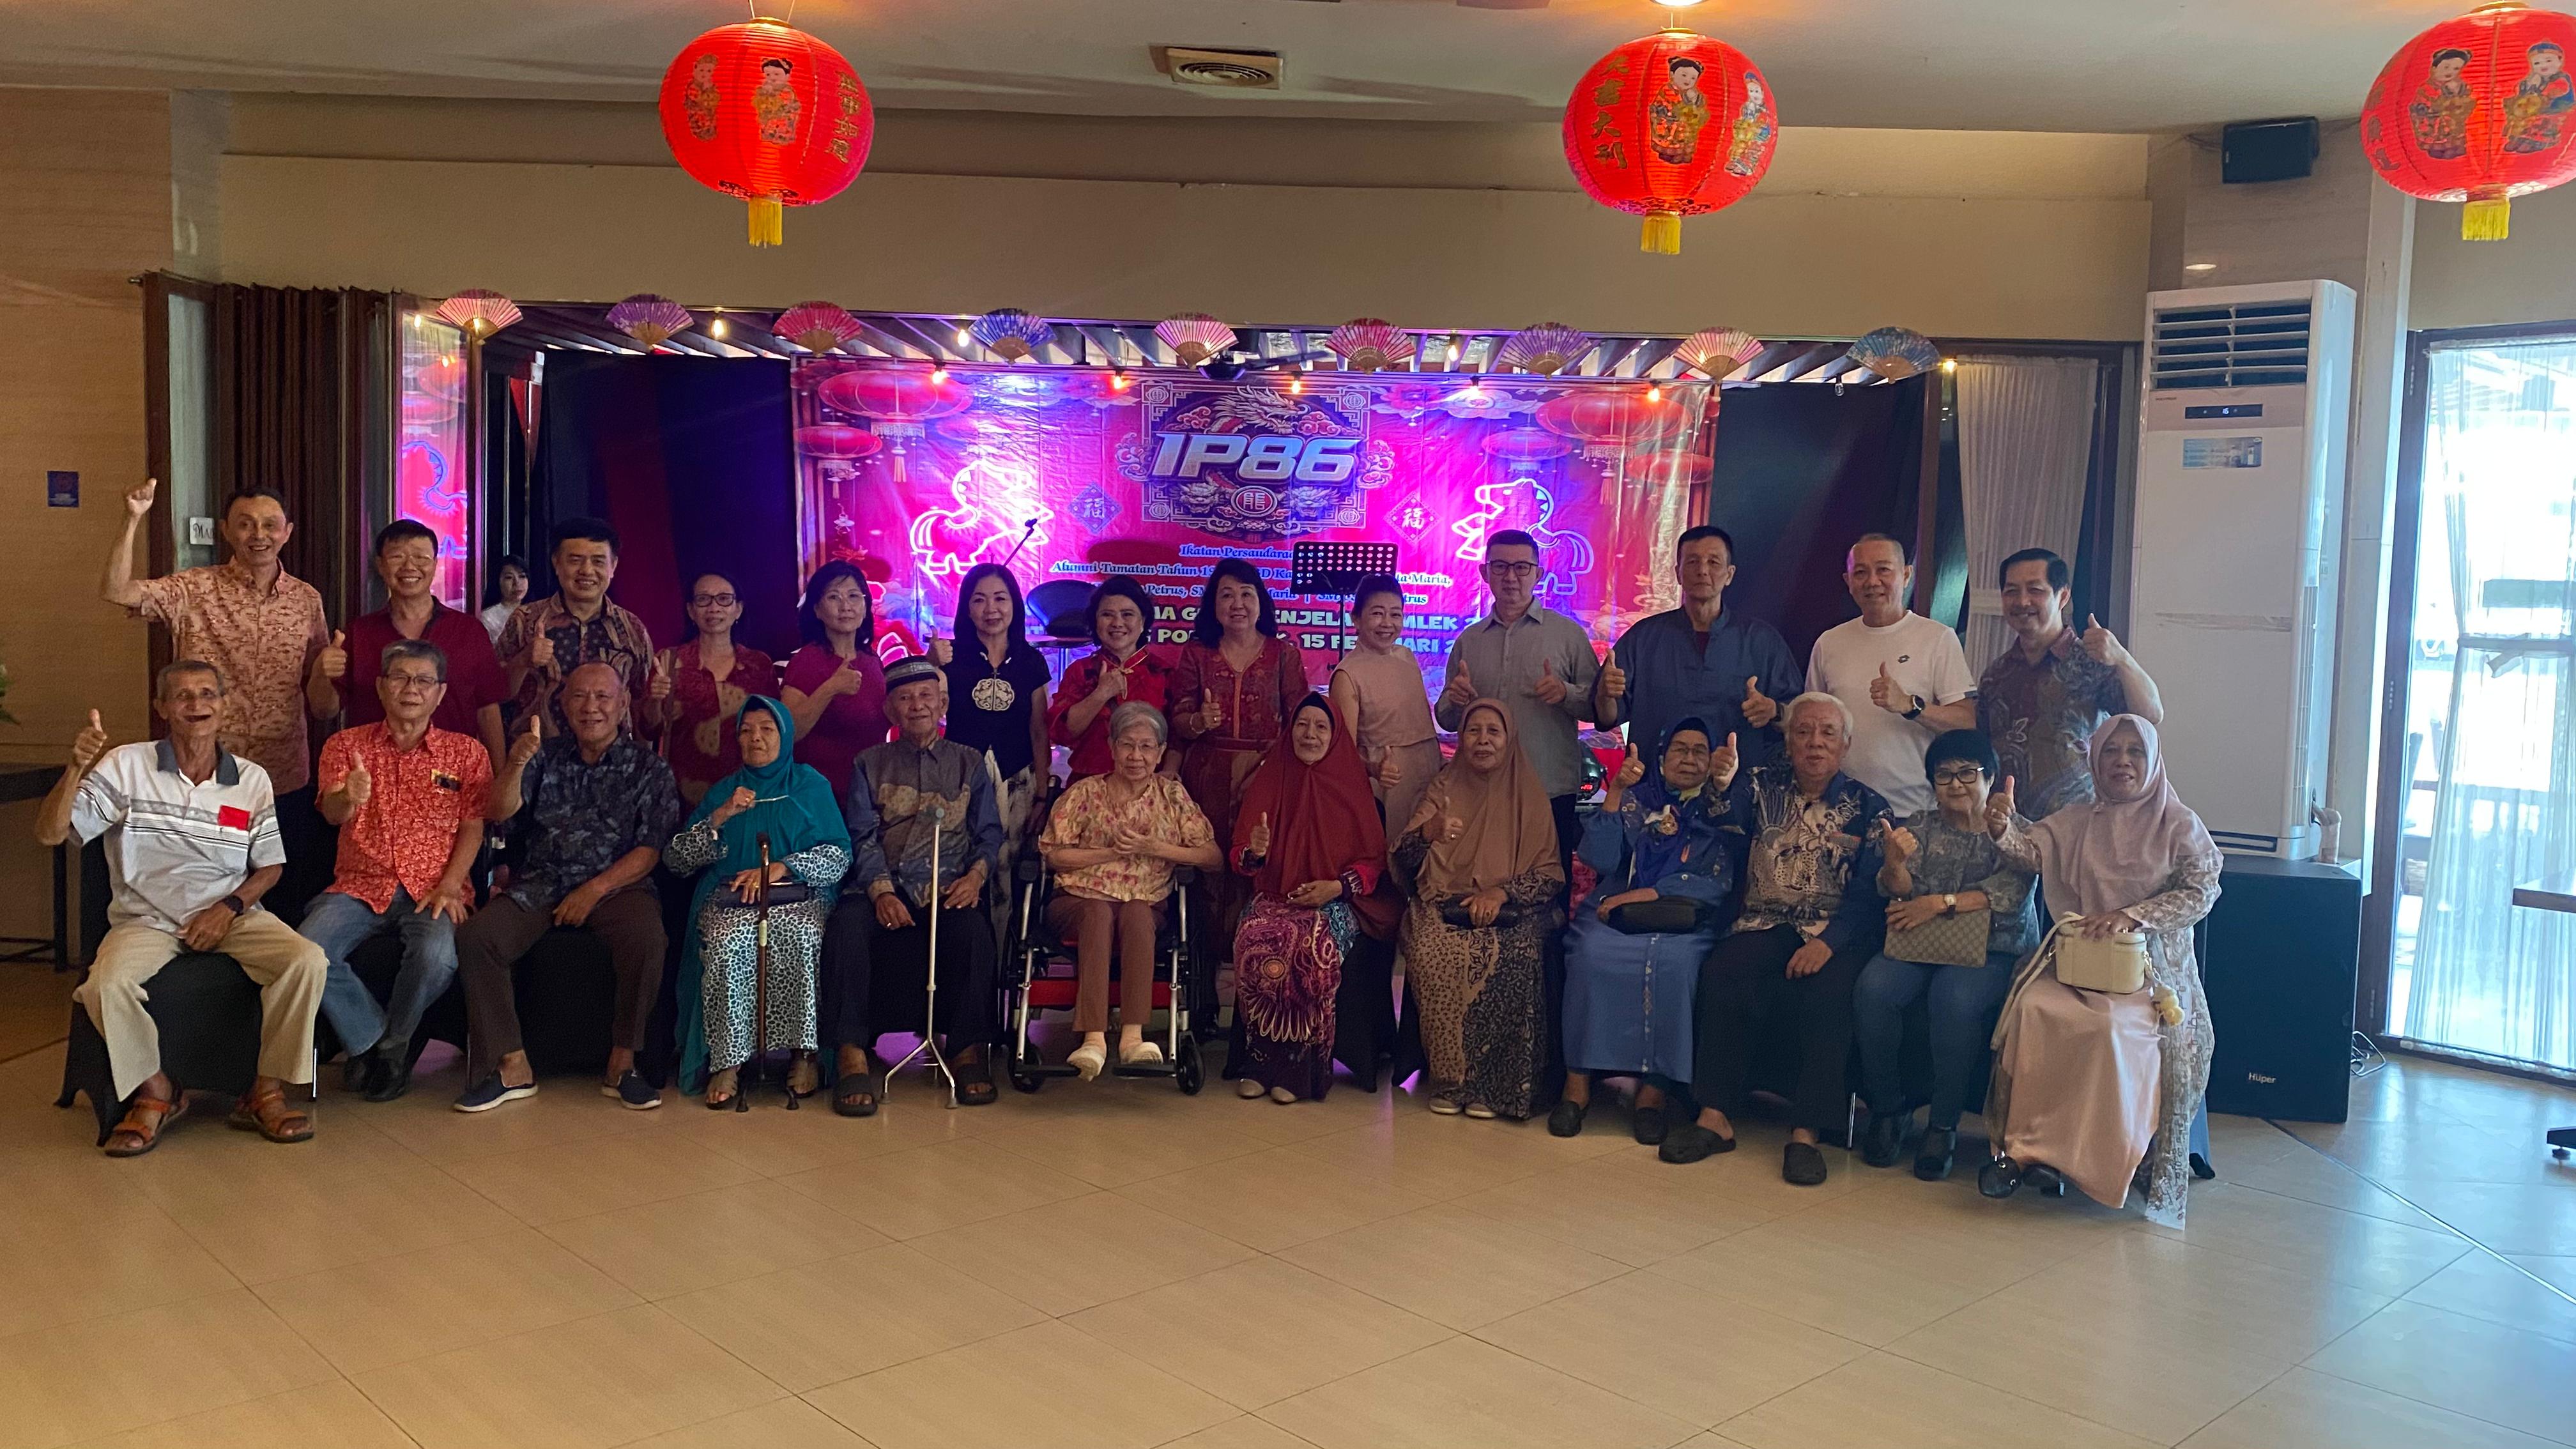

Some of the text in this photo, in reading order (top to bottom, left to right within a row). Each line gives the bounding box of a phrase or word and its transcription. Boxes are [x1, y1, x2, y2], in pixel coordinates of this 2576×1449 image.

[1402, 508, 1425, 529] 福
[1179, 544, 1293, 559] Ikatan Persaudara
[1051, 560, 1099, 573] Alumni
[1100, 562, 1156, 574] Tamatan
[1157, 564, 1199, 576] Tahun
[1411, 574, 1452, 586] Maria,
[1146, 584, 1188, 597] Petrus,
[1301, 634, 1325, 648] 15
